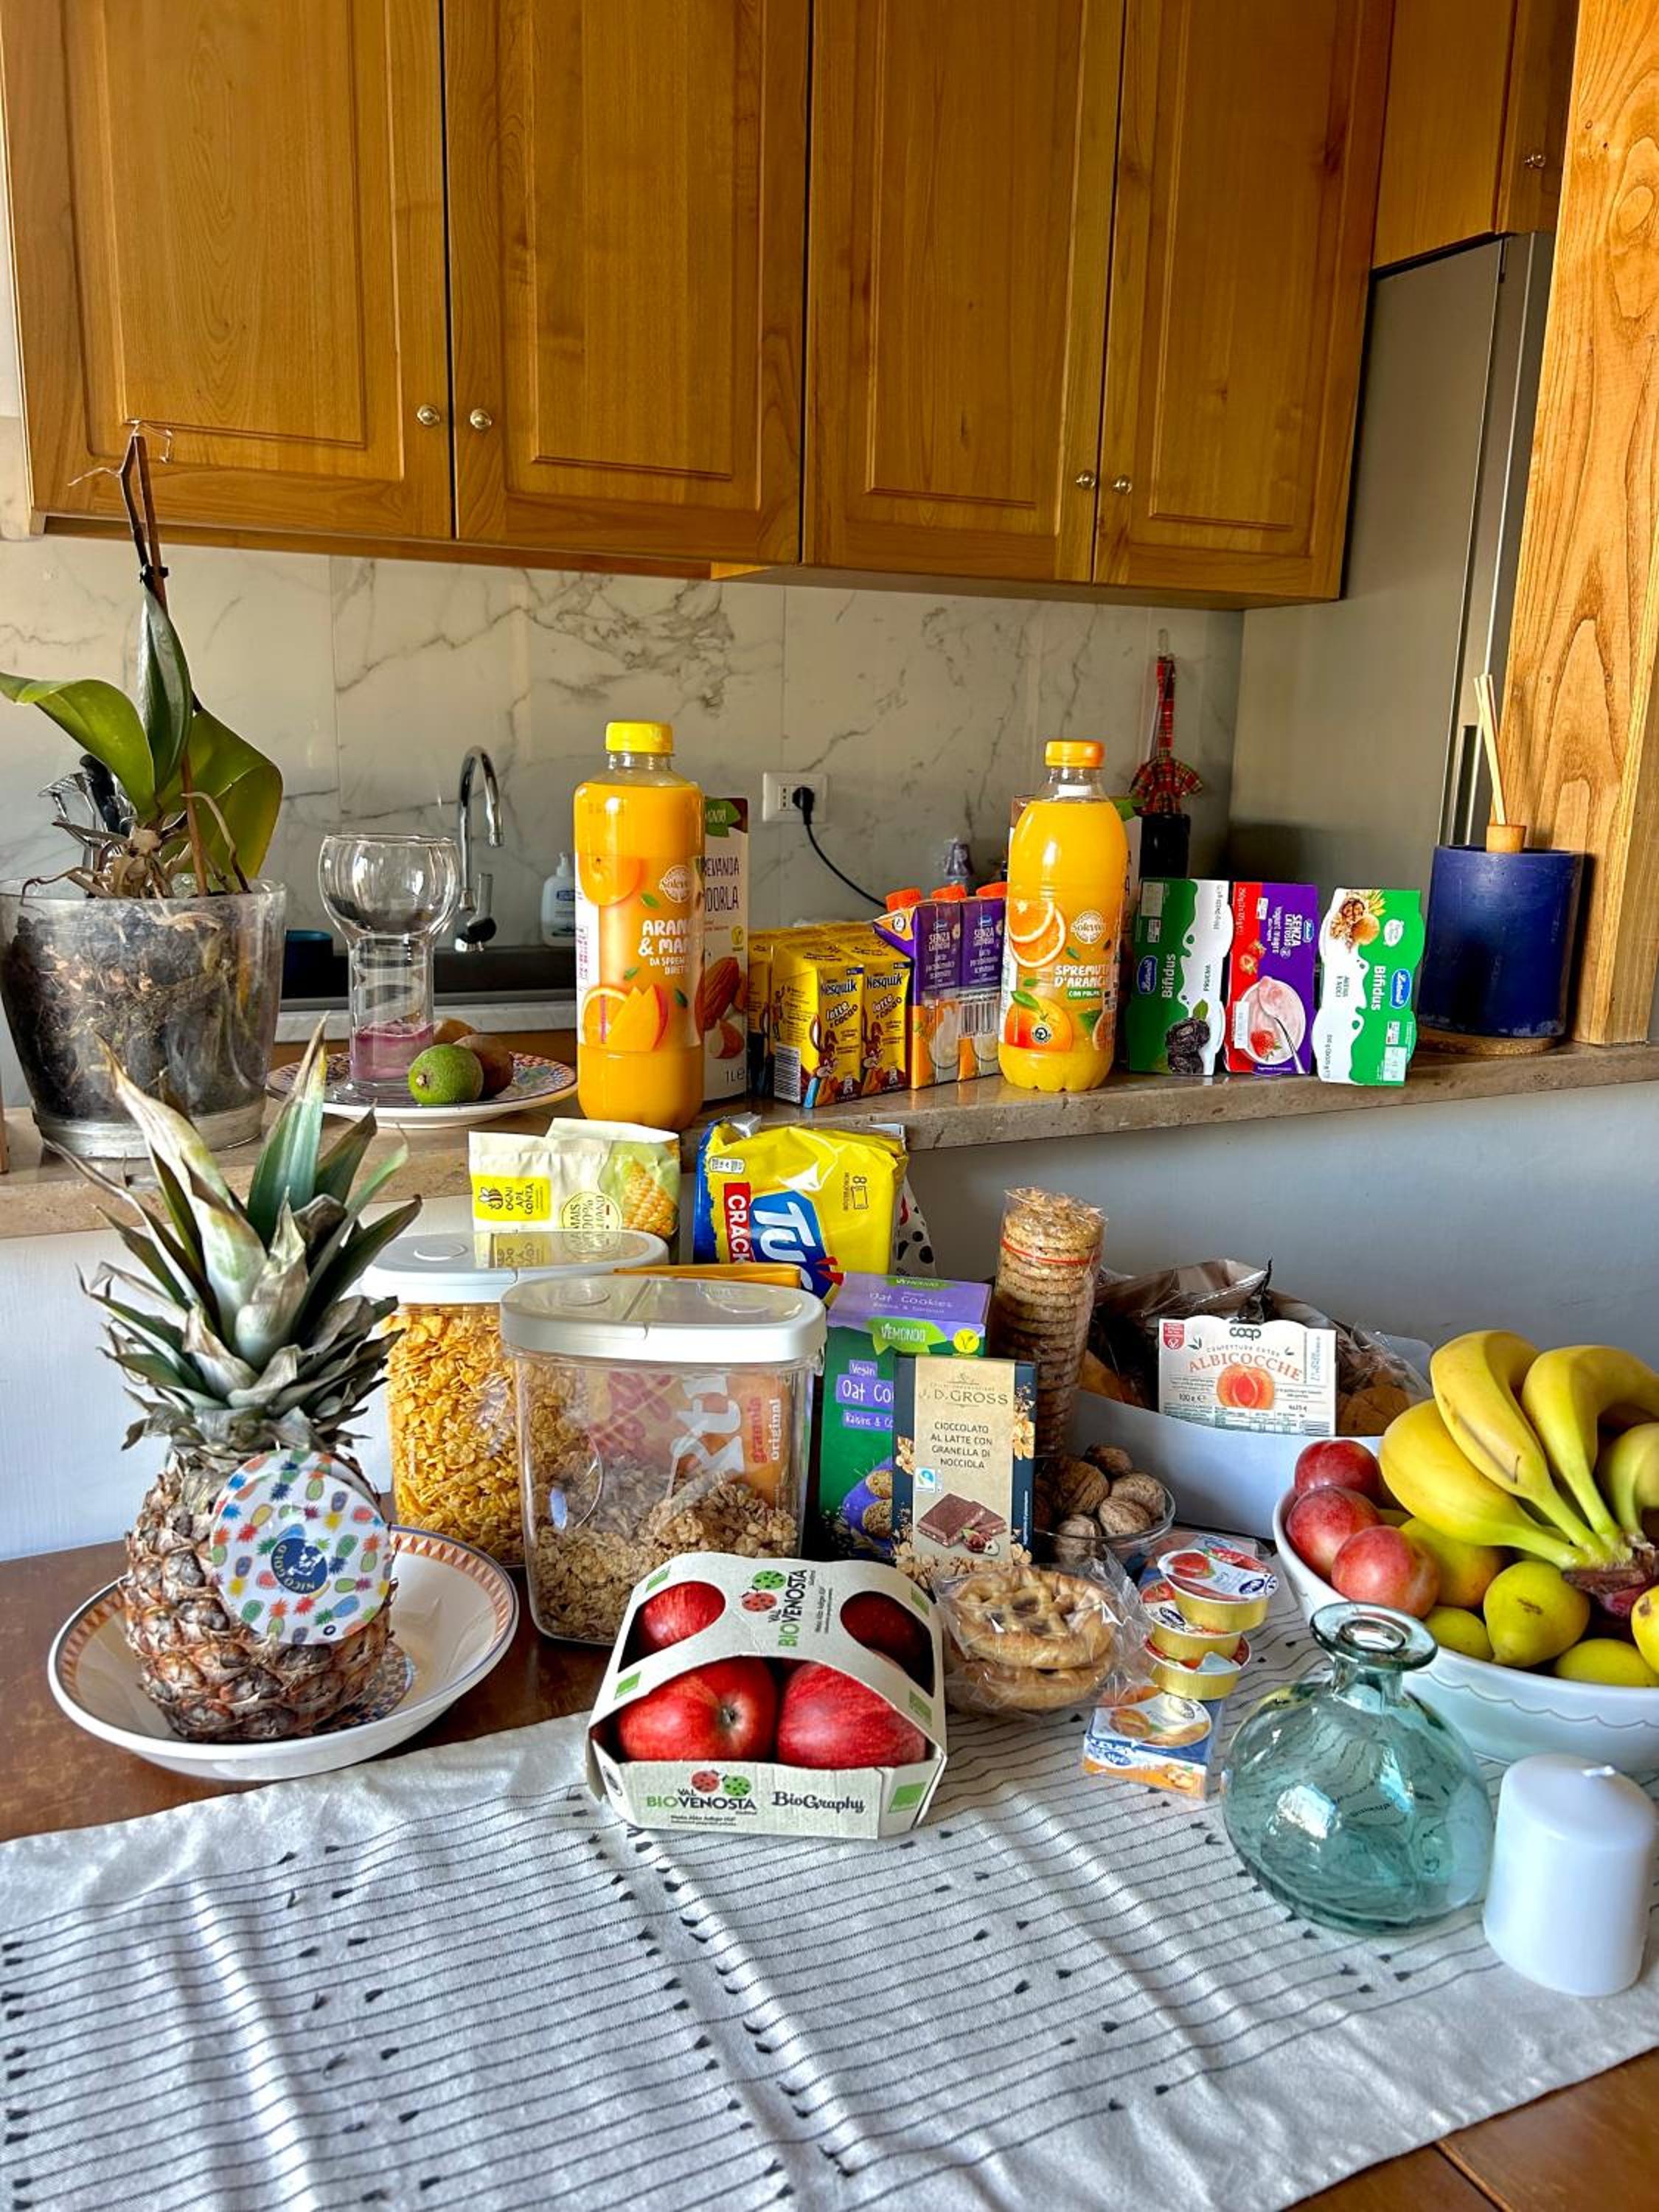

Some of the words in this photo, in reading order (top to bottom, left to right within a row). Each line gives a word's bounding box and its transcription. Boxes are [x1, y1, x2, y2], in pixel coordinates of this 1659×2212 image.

[1292, 914, 1302, 947] SENZA
[638, 937, 654, 956] &
[1054, 964, 1109, 975] SPREMUT
[1161, 953, 1175, 998] Bifidus
[821, 978, 858, 995] Nesquik
[866, 973, 902, 990] Nesquik
[1054, 975, 1108, 988] D'ARANC
[1371, 965, 1386, 1011] Bifidus
[826, 1001, 849, 1021] latte
[834, 1004, 858, 1027] cacao
[852, 1176, 867, 1184] 8
[525, 1183, 535, 1215] CONTA
[901, 1295, 954, 1308] Cookies
[881, 1322, 926, 1343] VEMONDO
[1229, 1327, 1262, 1340] coop
[1188, 1351, 1304, 1382] ALBICOCCHE
[841, 1380, 866, 1402] Oat
[874, 1384, 894, 1403] Co
[746, 1397, 768, 1464] granola
[768, 1398, 782, 1461] original
[934, 1422, 990, 1434] CIOCCOLATO
[931, 1433, 942, 1442] AL
[945, 1434, 971, 1444] LATTE
[974, 1436, 992, 1446] CON
[931, 1445, 978, 1456] GRANELLA
[981, 1449, 990, 1458] DI
[940, 1458, 985, 1469] NOCCIOLA
[768, 1609, 782, 1624] VAL
[778, 1568, 808, 1648] BIOVENOSTA
[678, 1788, 697, 1797] VAL
[646, 1795, 757, 1811] BIOVENOSTA
[772, 1791, 866, 1815] BioGraphy
